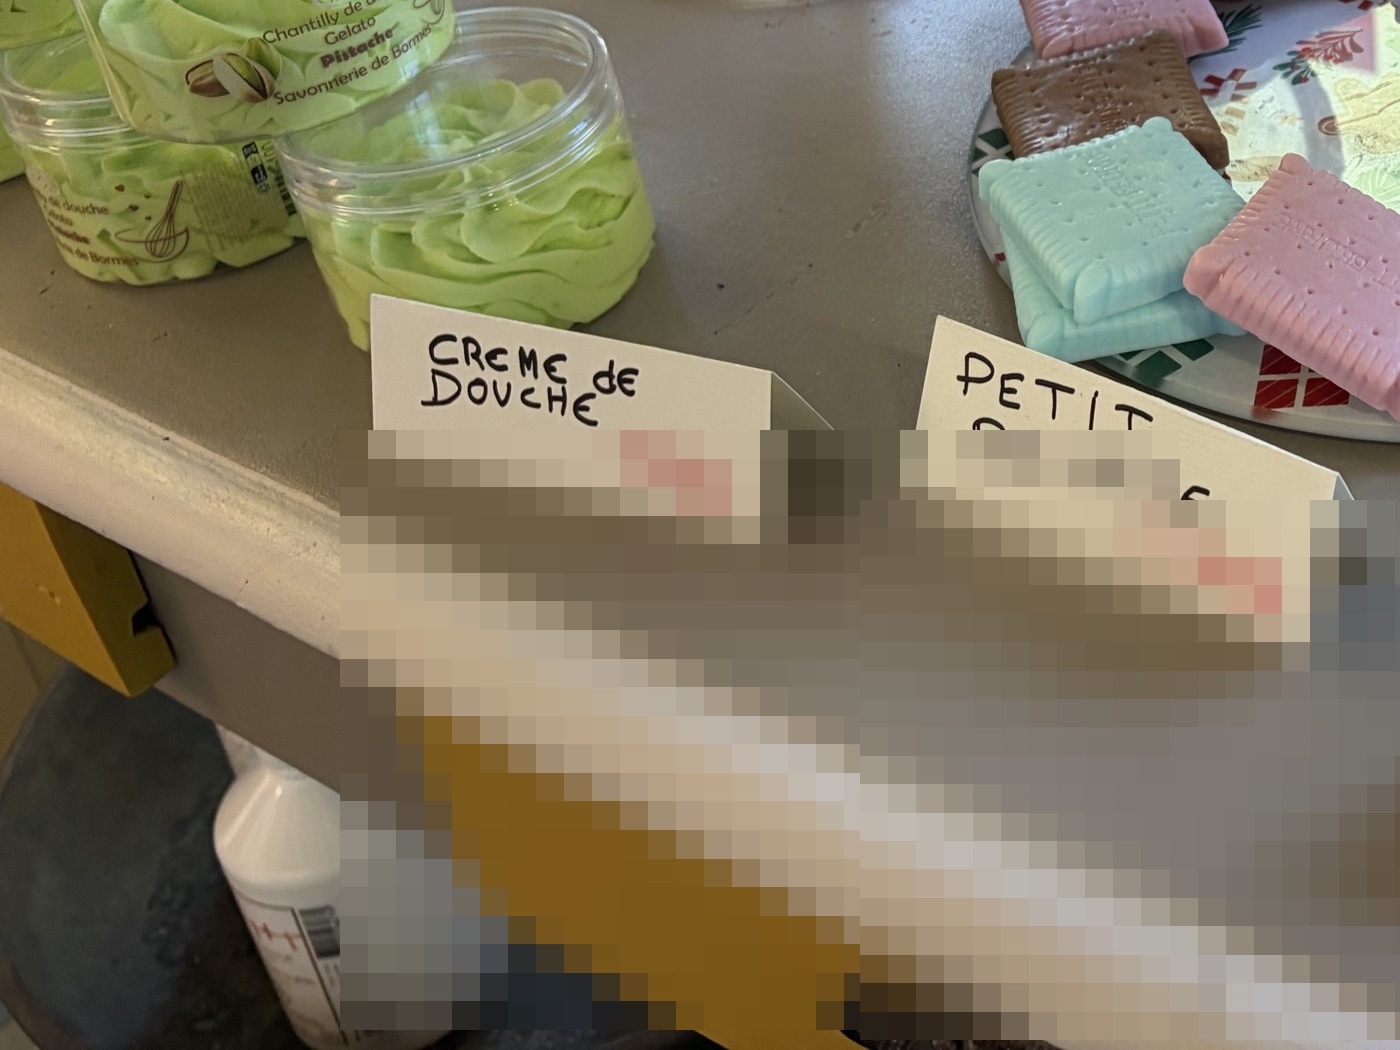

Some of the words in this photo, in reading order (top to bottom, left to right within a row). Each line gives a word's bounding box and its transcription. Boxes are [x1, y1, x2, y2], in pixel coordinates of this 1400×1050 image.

[262, 12, 340, 45] Chantilly
[343, 1, 362, 17] de
[324, 16, 377, 46] Gelato
[274, 67, 369, 105] Savonnerie
[371, 55, 390, 71] de
[391, 25, 432, 60] Bormes
[320, 27, 394, 70] Pistache
[63, 199, 109, 216] douche
[89, 251, 139, 267] Bormes
[428, 333, 568, 385] CREME
[420, 368, 599, 427] DOUCHE
[956, 351, 1154, 431] PETIT
